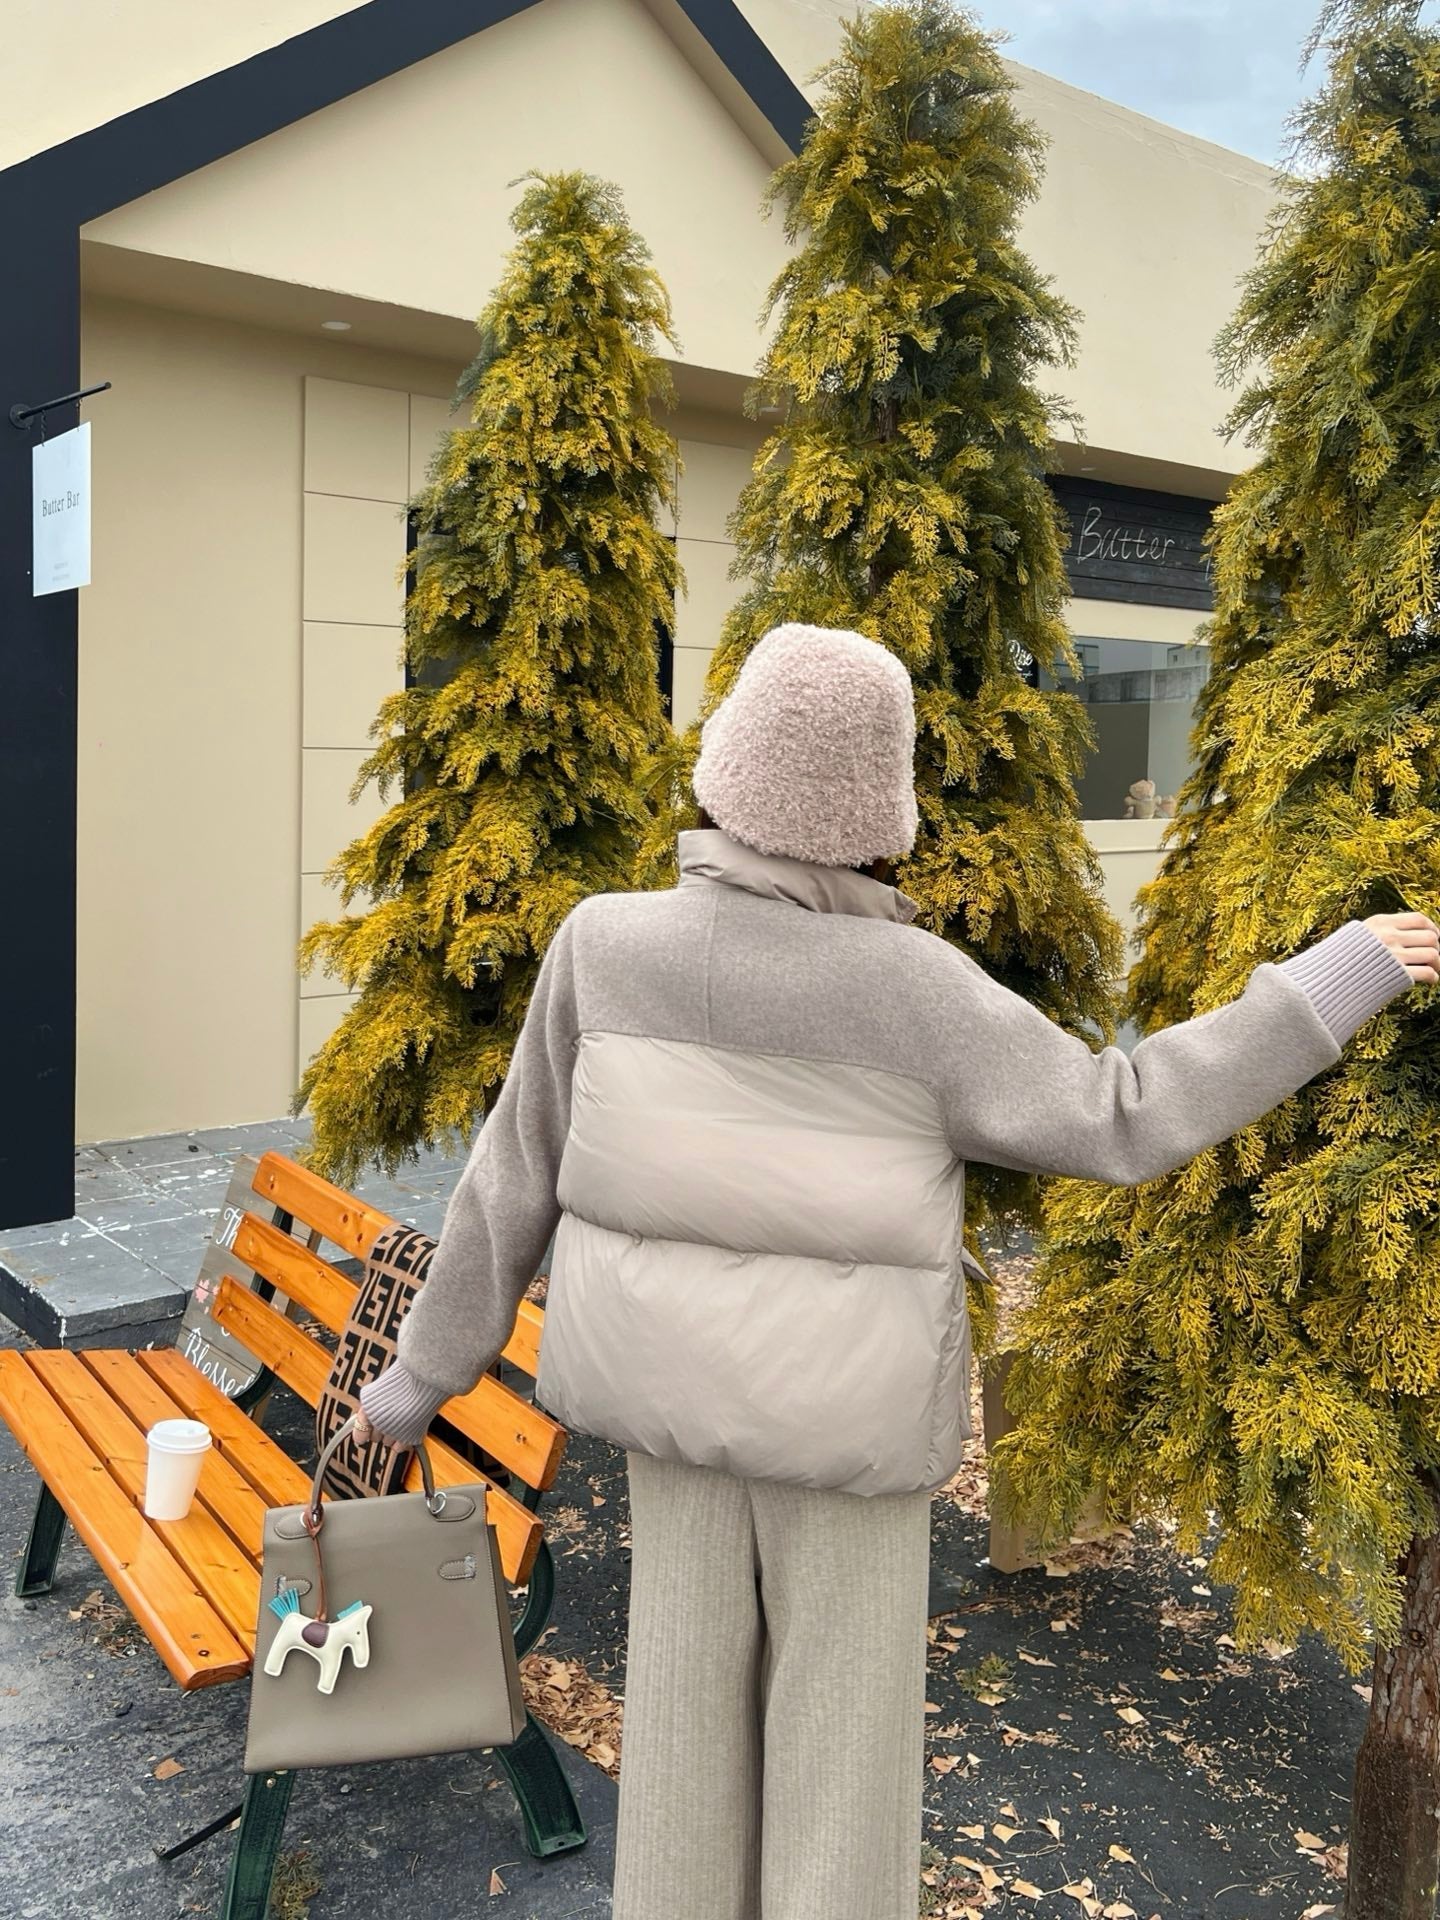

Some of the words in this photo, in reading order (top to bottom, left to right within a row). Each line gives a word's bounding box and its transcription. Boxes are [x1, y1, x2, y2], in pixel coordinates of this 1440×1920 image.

[42, 498, 65, 518] Butter
[67, 490, 80, 510] Bar
[1076, 503, 1176, 565] Butter
